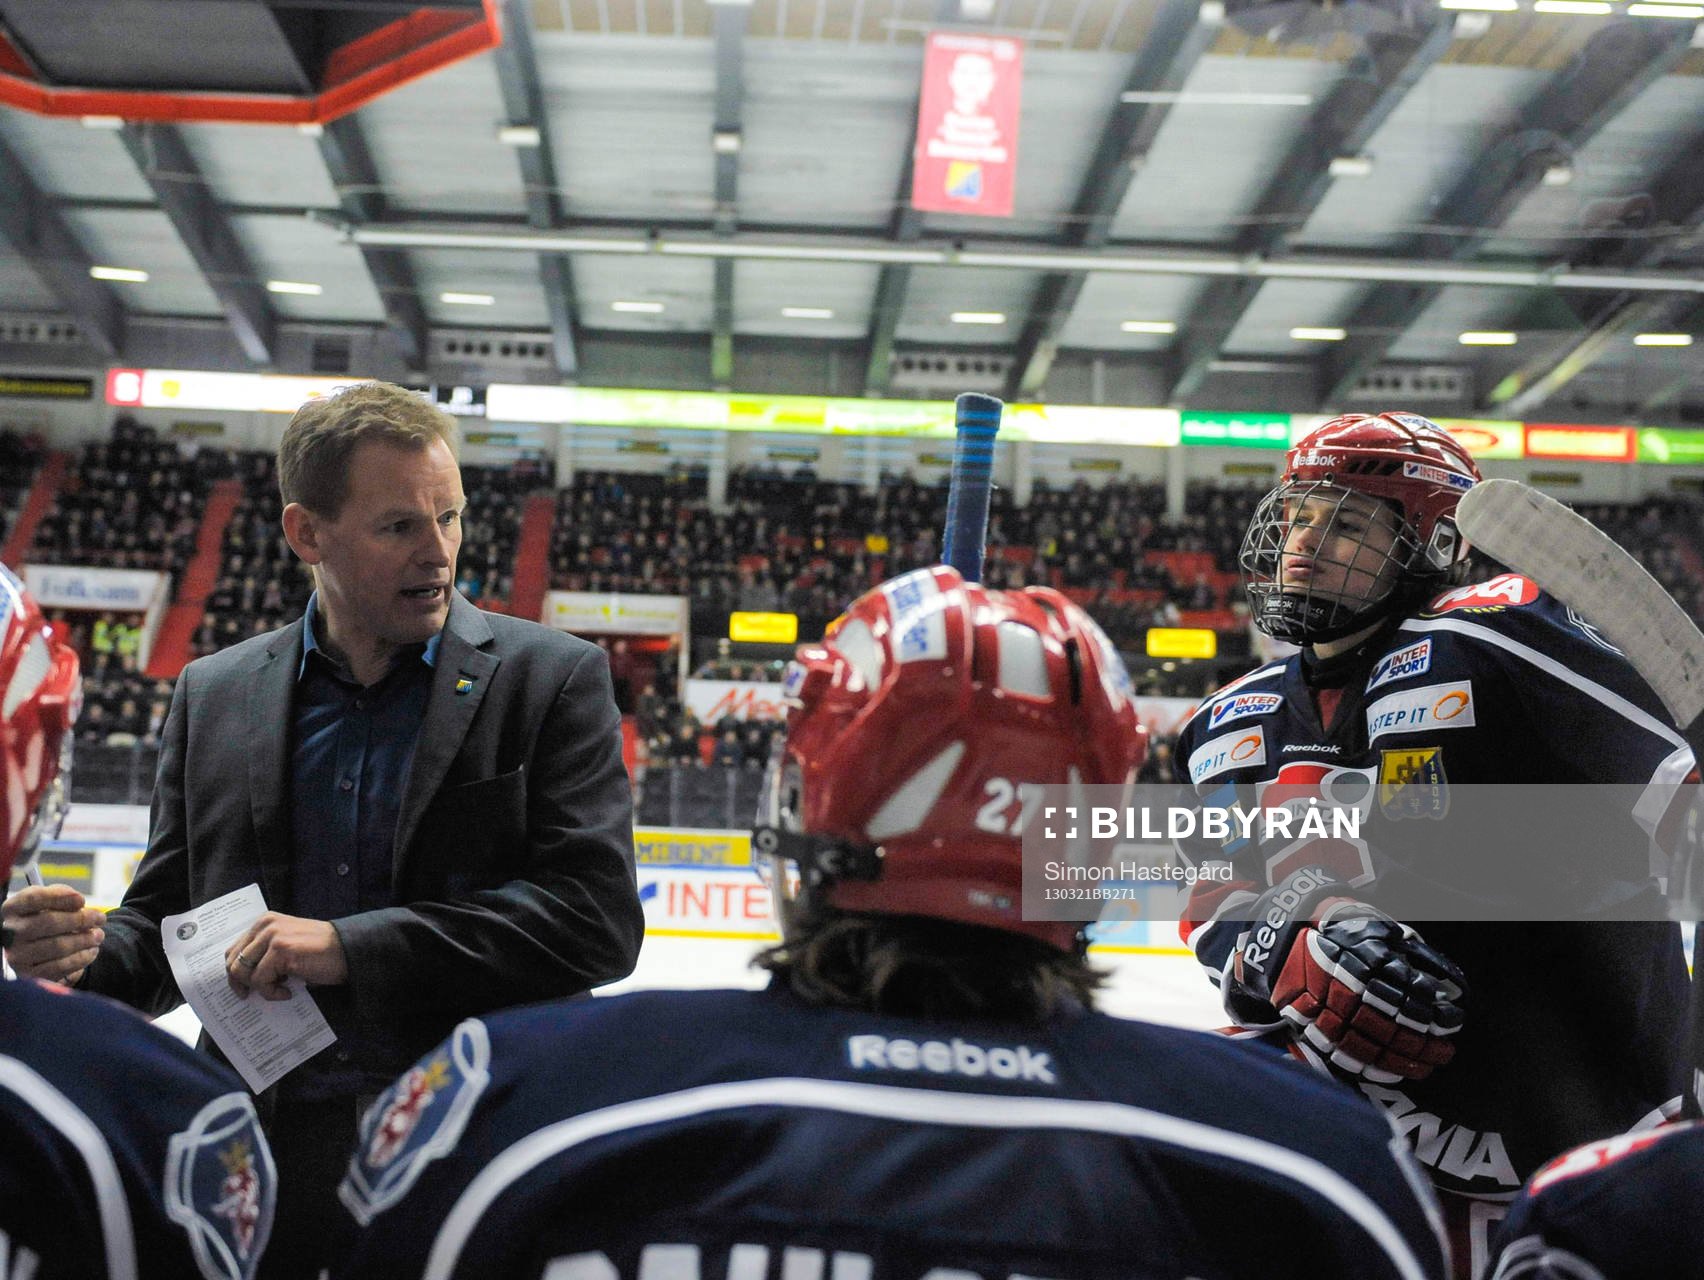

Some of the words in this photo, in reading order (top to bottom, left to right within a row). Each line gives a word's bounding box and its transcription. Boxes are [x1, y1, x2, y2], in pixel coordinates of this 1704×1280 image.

[1388, 655, 1427, 678] SPORT
[1392, 644, 1429, 667] INTER
[1233, 703, 1274, 717] SPORT
[1236, 696, 1280, 706] INTER
[1282, 744, 1342, 755] Reebok
[975, 777, 1045, 837] 27
[1243, 868, 1337, 974] Reebok
[848, 1034, 1057, 1085] Reebok
